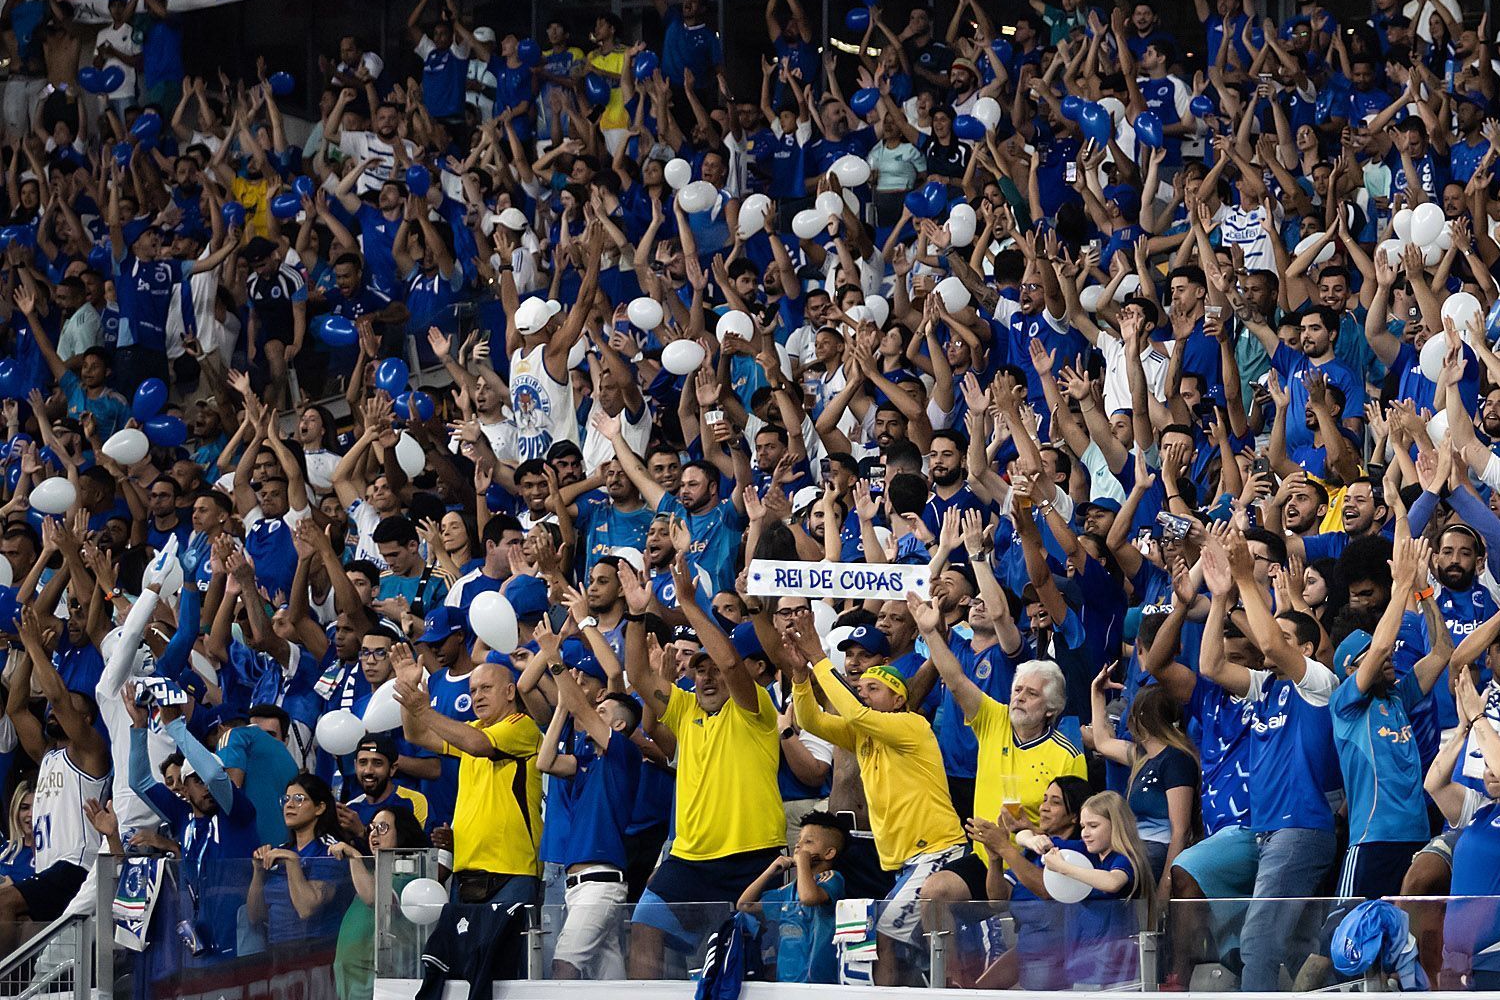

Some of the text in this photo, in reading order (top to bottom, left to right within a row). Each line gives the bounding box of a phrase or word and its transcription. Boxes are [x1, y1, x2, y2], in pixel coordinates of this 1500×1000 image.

[774, 568, 904, 592] REI DE COPAS
